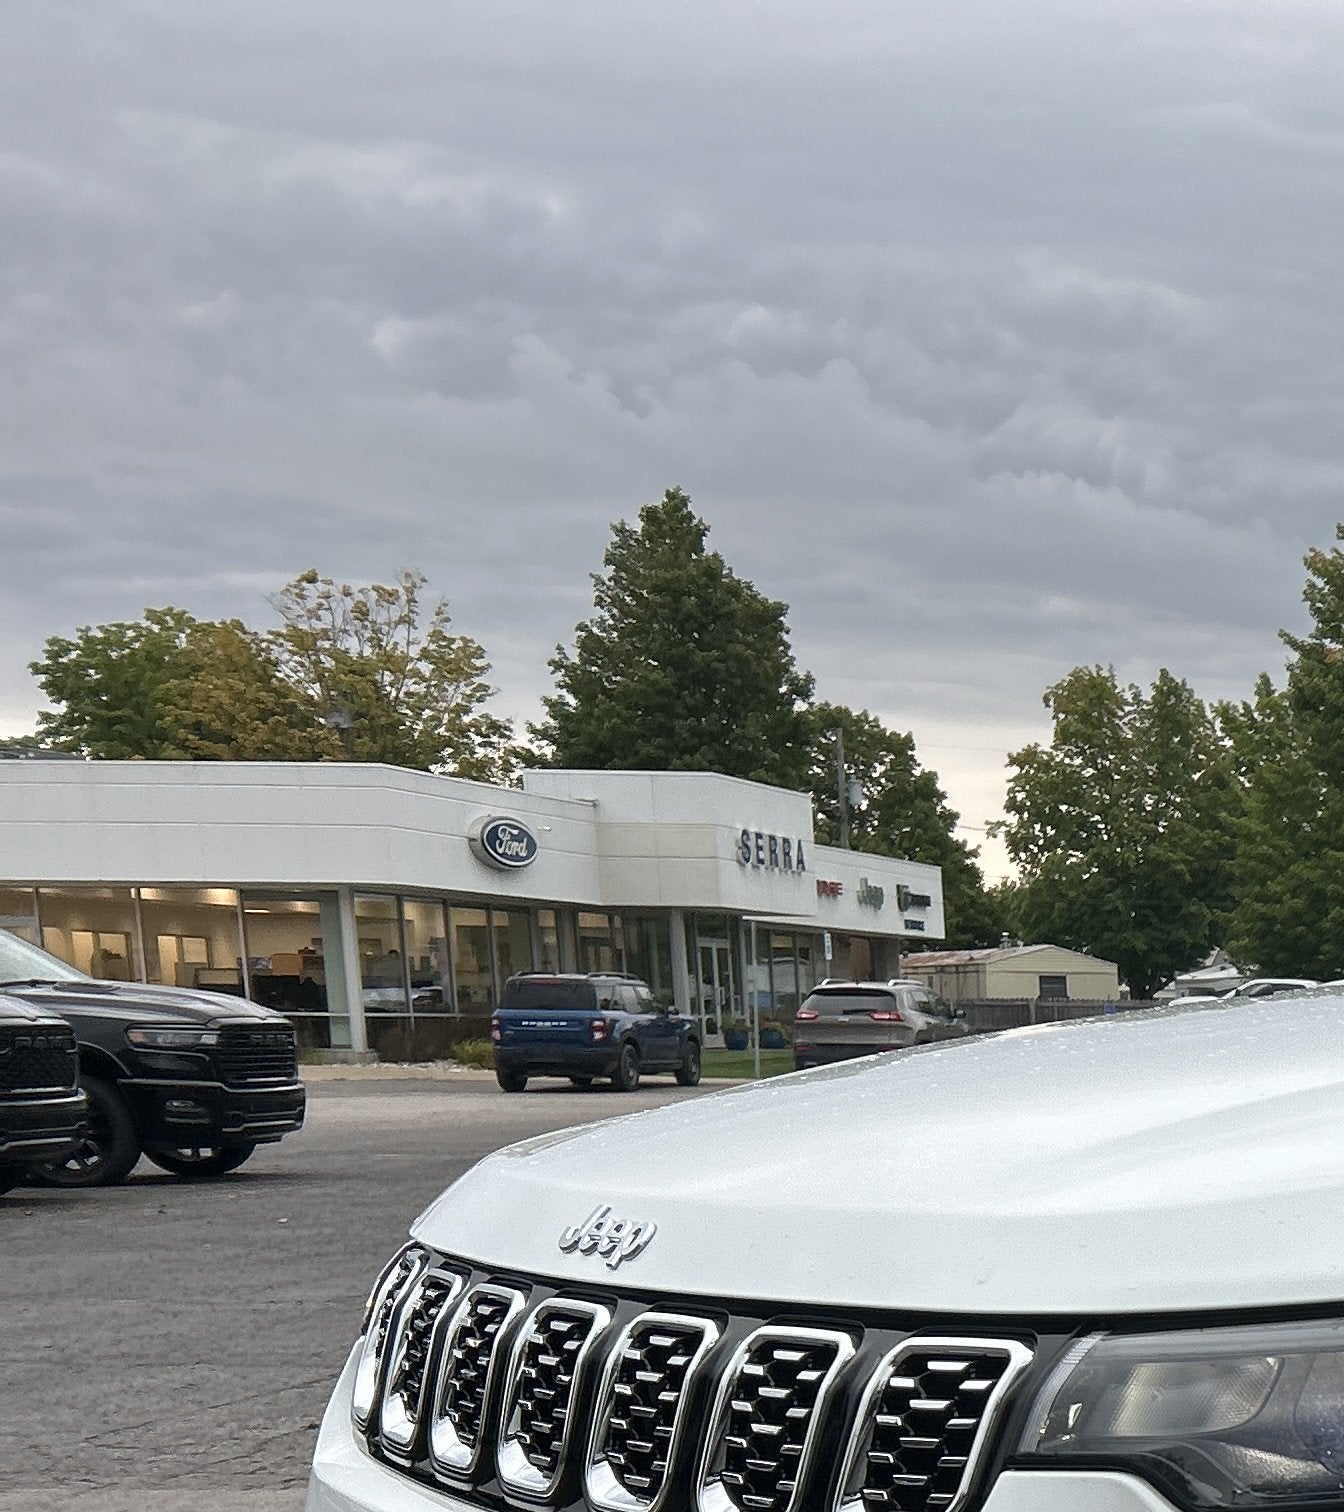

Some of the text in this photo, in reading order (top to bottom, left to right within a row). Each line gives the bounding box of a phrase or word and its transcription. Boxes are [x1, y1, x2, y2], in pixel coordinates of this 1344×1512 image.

[495, 825, 528, 857] Ford
[741, 828, 805, 872] SERRA
[558, 1204, 658, 1271] Jeep
